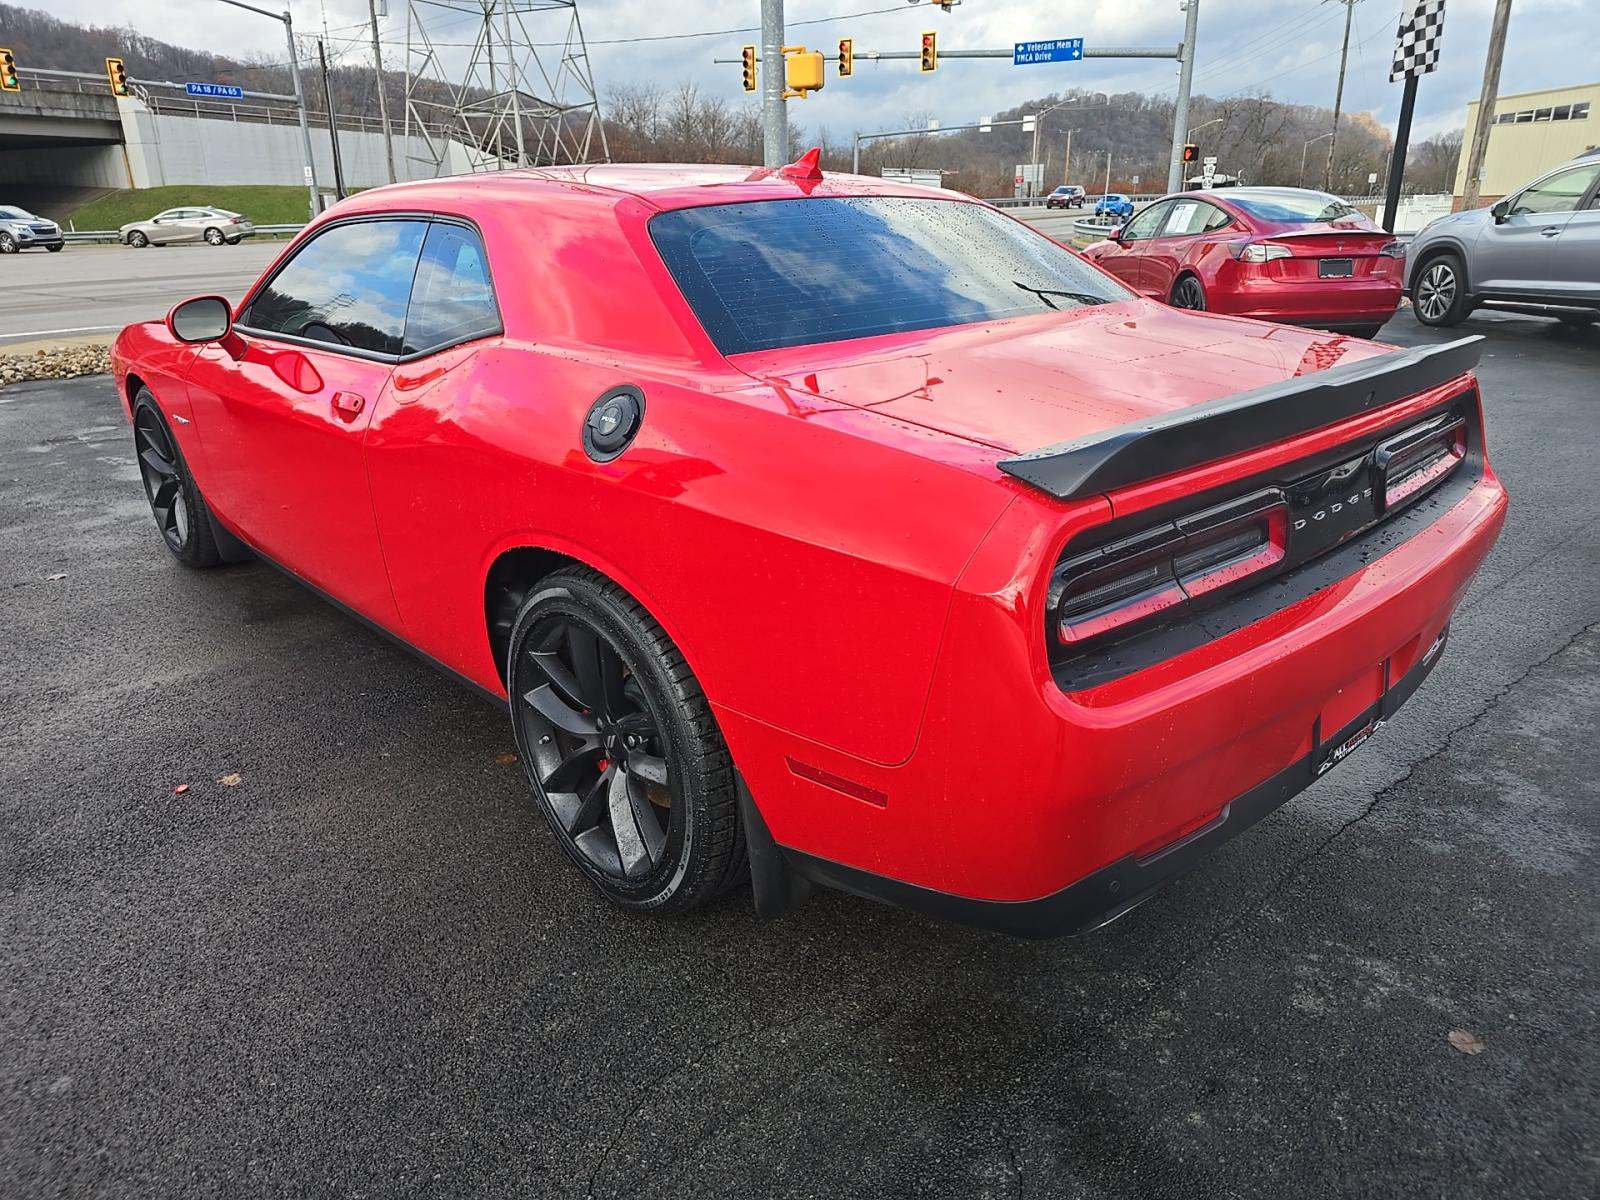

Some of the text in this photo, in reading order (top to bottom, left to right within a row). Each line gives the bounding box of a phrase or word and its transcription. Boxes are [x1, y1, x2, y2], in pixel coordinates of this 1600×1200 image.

[1027, 42, 1055, 52] Veterans
[1056, 41, 1071, 49] Mem
[1017, 52, 1052, 62] YMCA Drive
[191, 84, 202, 92] PA
[218, 87, 228, 95] PA
[229, 88, 237, 96] 65
[1205, 166, 1213, 174] 18
[1293, 488, 1373, 530] DODGE
